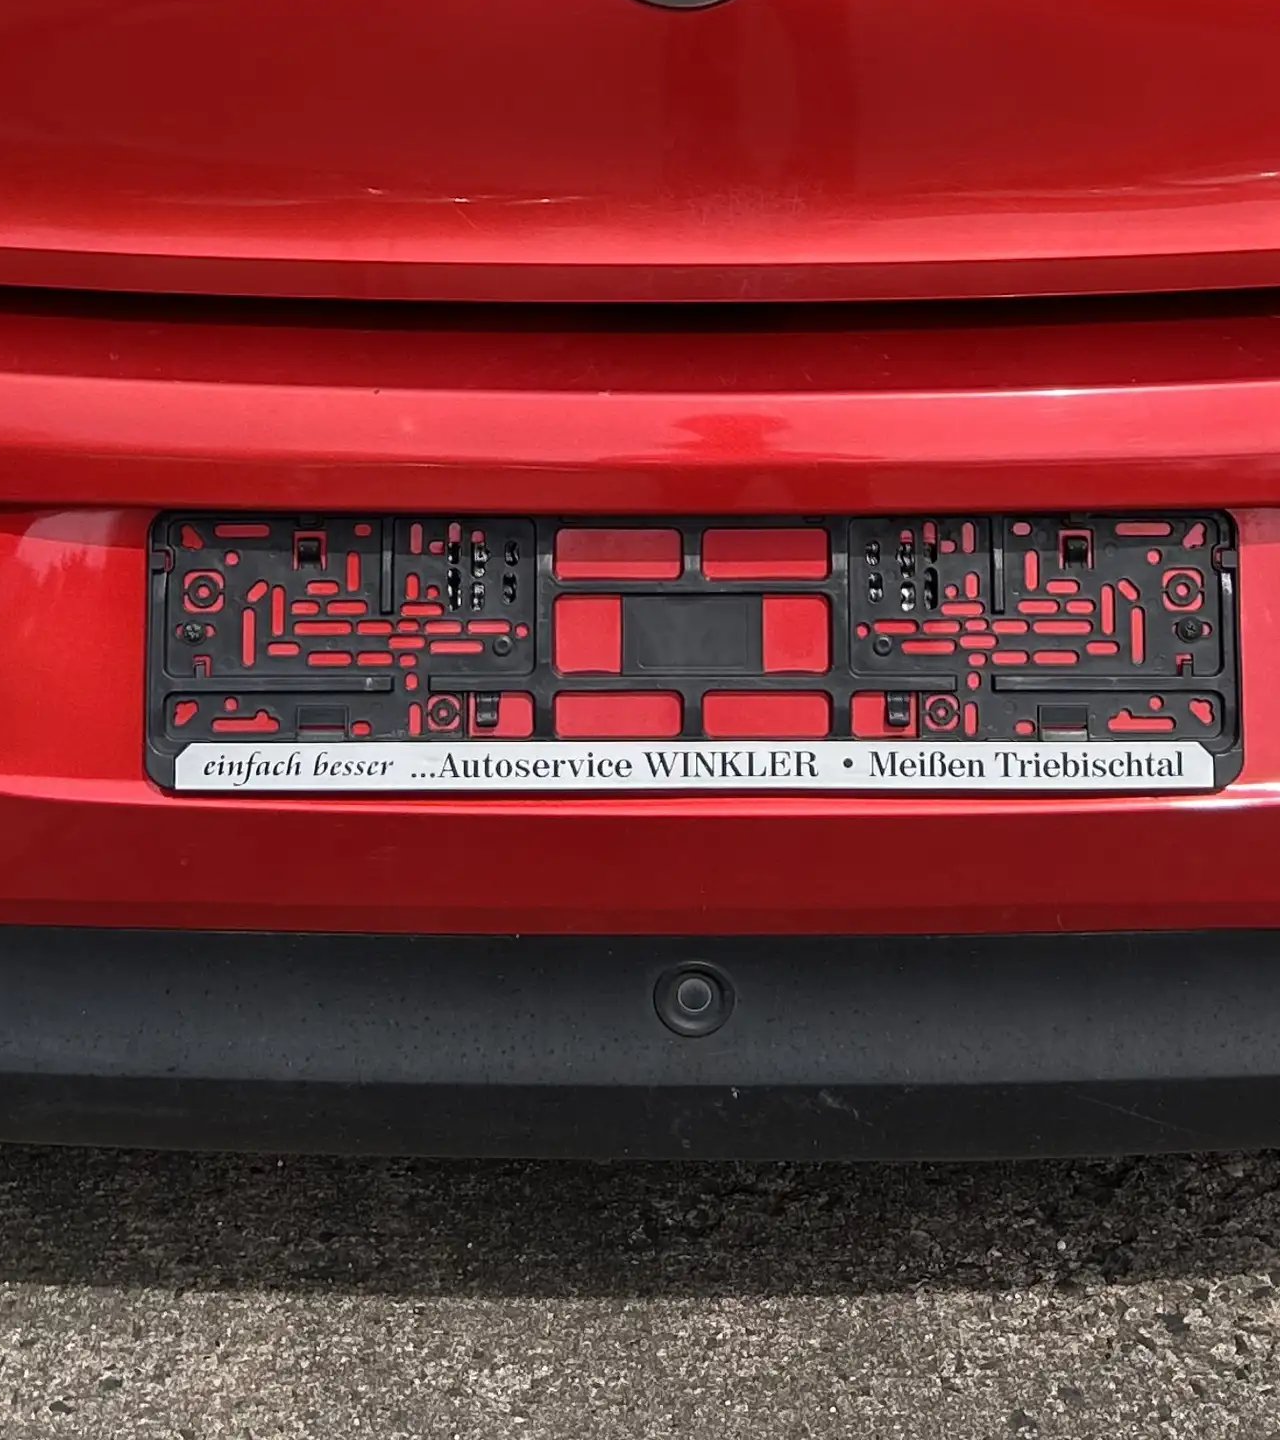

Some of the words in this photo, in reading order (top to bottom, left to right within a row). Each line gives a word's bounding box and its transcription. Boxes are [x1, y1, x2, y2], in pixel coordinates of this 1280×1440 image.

[203, 750, 302, 787] einfach
[312, 750, 395, 777] besser
[641, 750, 820, 778] WINKLER
[868, 750, 986, 778] Meißen
[993, 750, 1185, 778] Triebischtal
